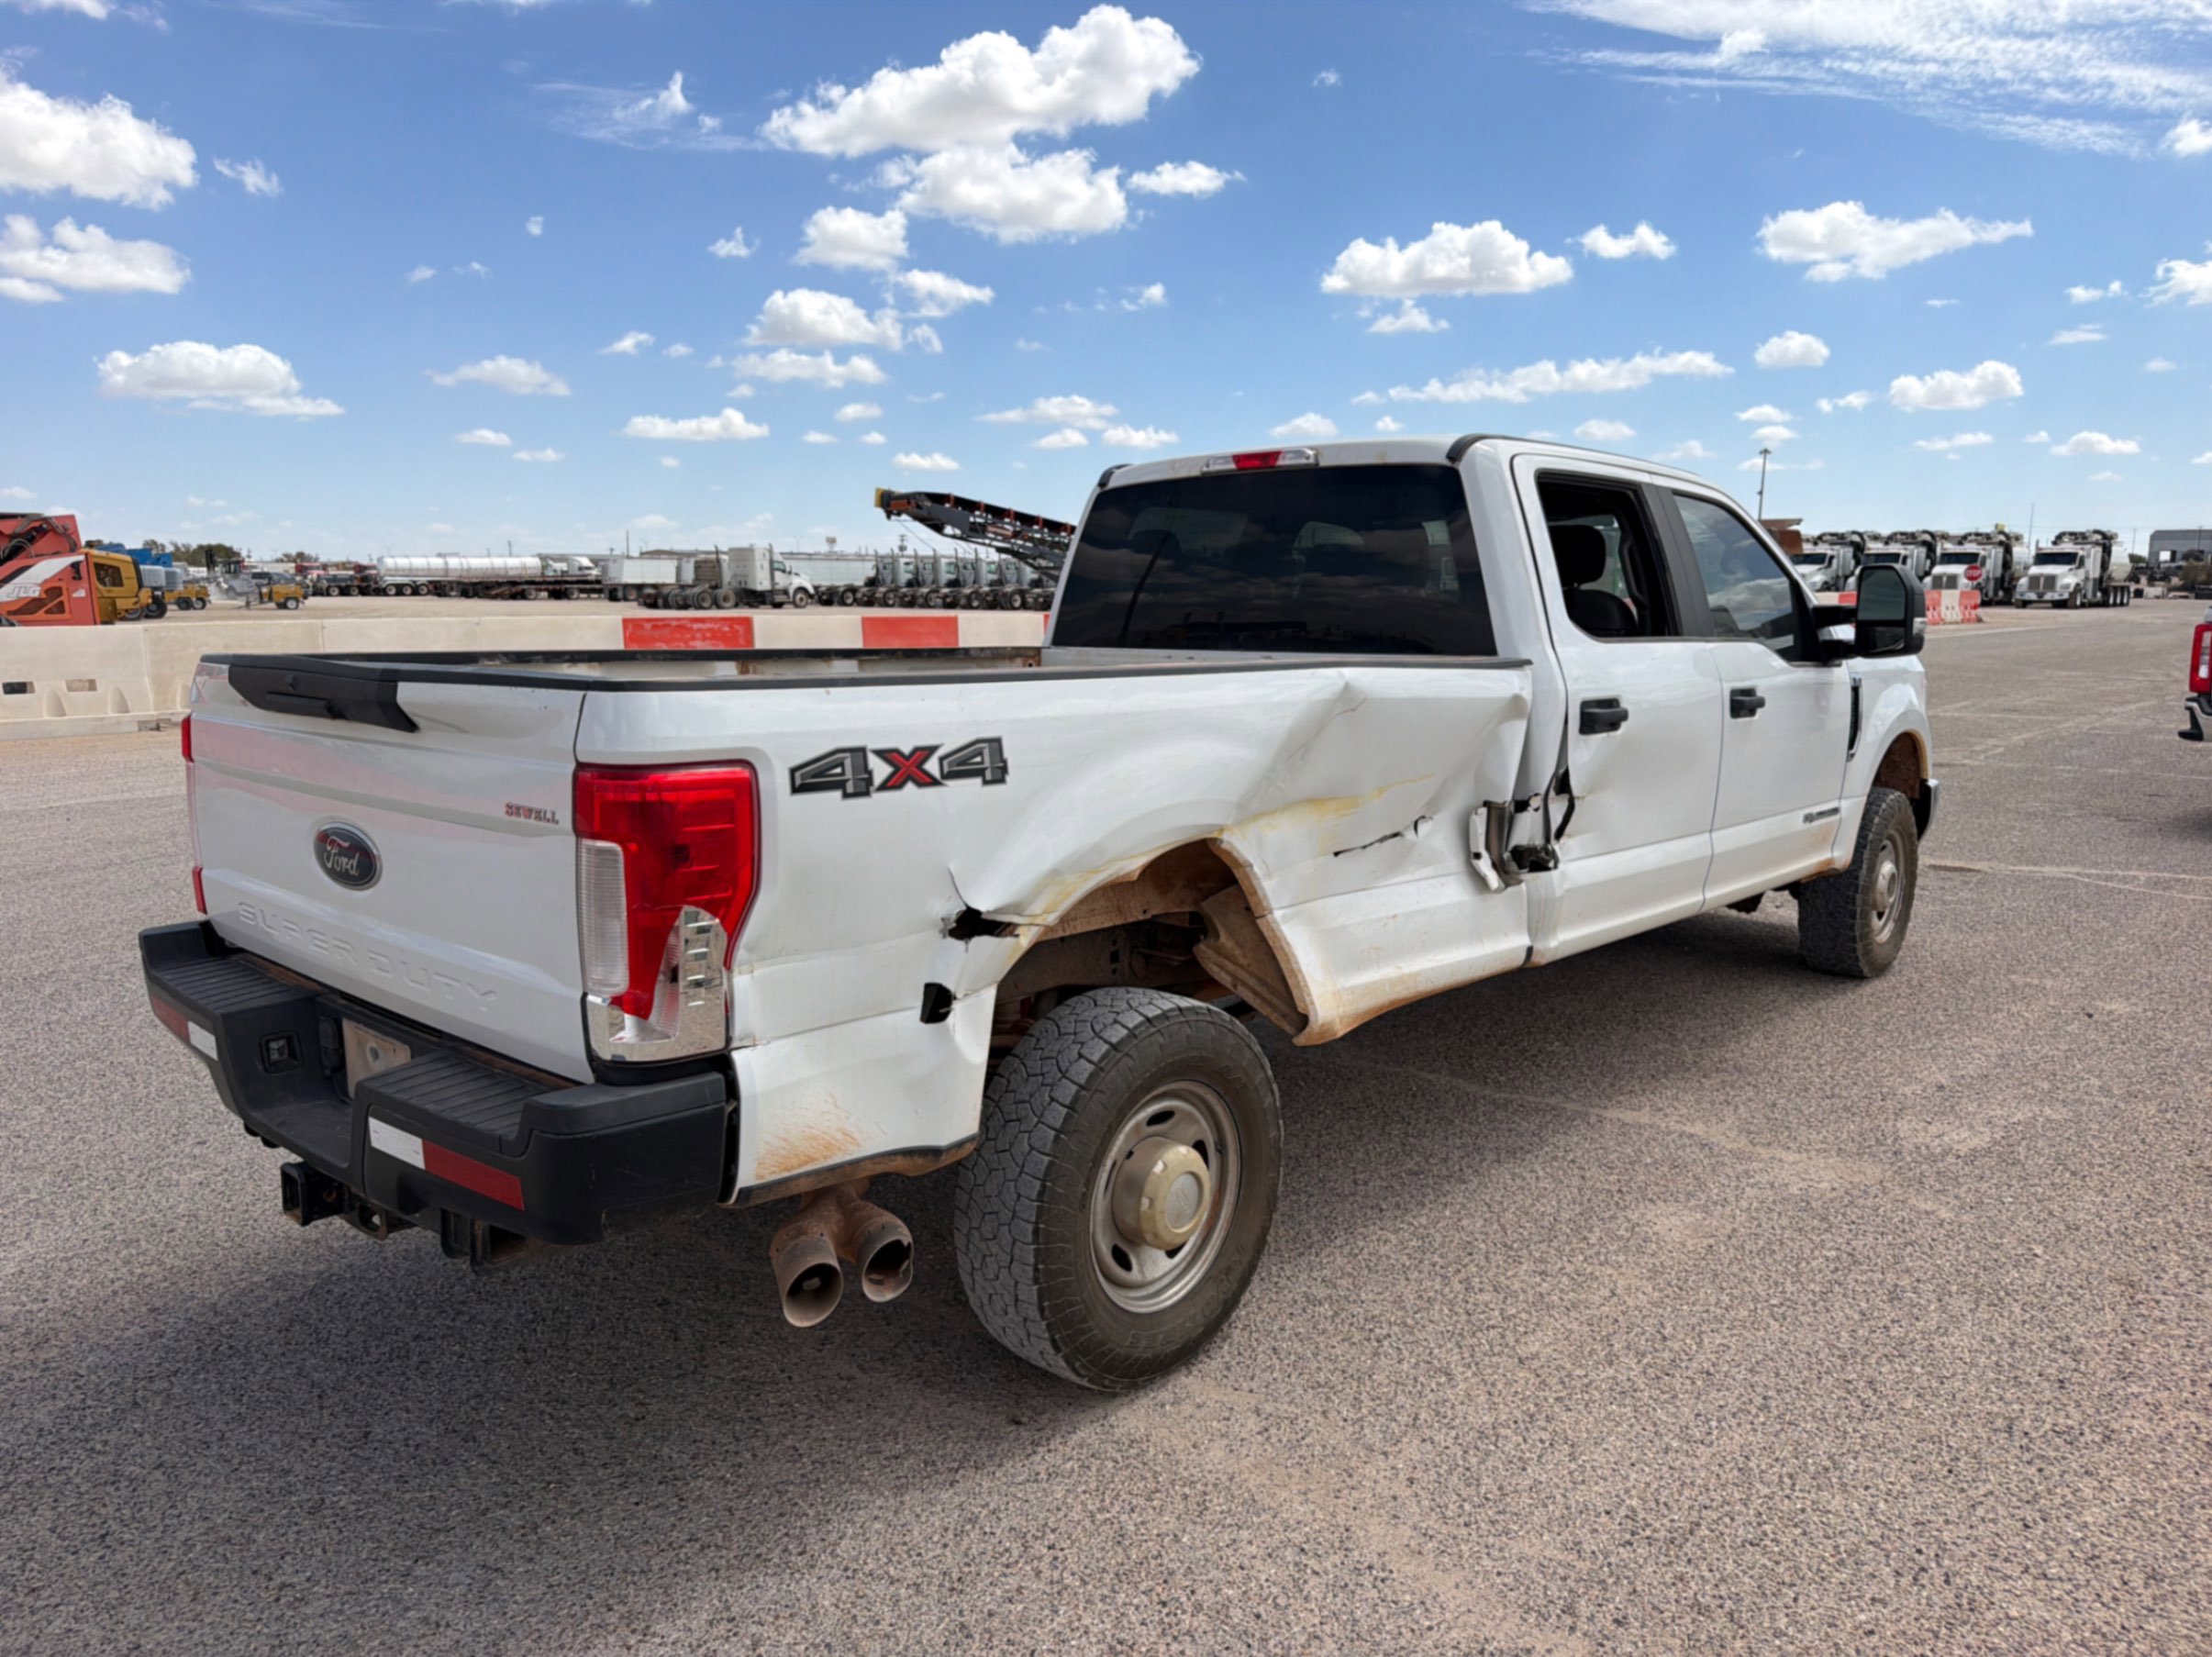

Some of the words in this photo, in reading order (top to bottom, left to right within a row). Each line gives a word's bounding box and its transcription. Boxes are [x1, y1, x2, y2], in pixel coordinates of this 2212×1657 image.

[1966, 569, 1982, 577] STOP
[7, 584, 39, 598] JLG
[505, 801, 559, 825] SEWELL
[324, 836, 360, 876] Ford
[239, 902, 358, 964] SUPER
[367, 950, 497, 1012] DUTY
